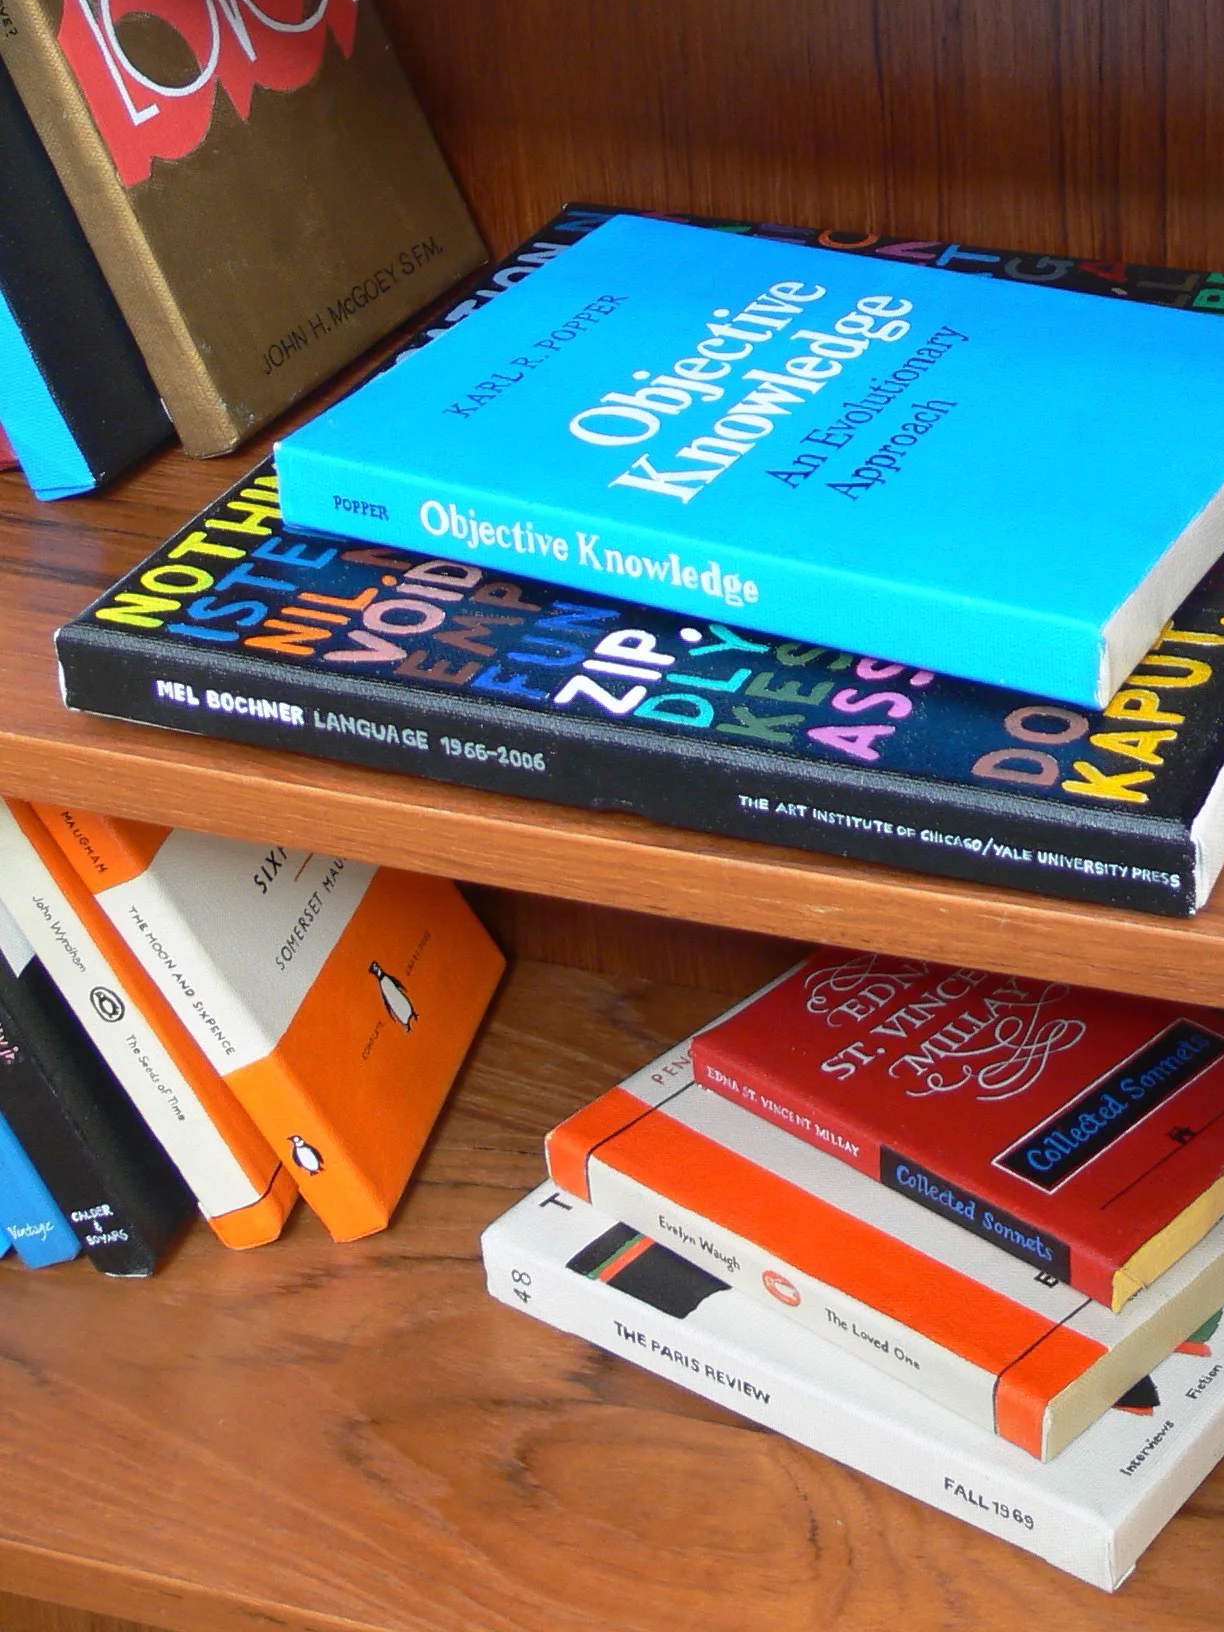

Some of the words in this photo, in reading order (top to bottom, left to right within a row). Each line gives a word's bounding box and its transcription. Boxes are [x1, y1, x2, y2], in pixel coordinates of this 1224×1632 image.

[263, 325, 308, 375] JOHN
[308, 312, 332, 340] H.
[328, 264, 399, 327] McGOEY
[442, 371, 524, 419] KARL
[533, 294, 629, 352] POPPER
[569, 280, 827, 446] Objective
[608, 294, 914, 505] Knowledge
[765, 453, 828, 489] An
[801, 325, 970, 450] Evolutionary
[826, 398, 958, 501] Approach
[333, 494, 390, 522] POPPER
[419, 499, 569, 561] Objective
[577, 531, 759, 608] Knowledge
[245, 575, 397, 656] NIL.
[324, 559, 483, 663] VOID
[553, 626, 702, 716] ZIP.
[156, 678, 200, 708] MEL
[206, 688, 305, 728] BOCHNER
[313, 709, 429, 751] LANGUAGE
[440, 735, 546, 772] 1966-2006
[61, 810, 107, 874] MAUGHAM
[737, 794, 769, 813] THE
[775, 800, 808, 820] ART
[812, 808, 896, 838] INSTITUTE
[897, 824, 917, 841] OF
[1037, 851, 1129, 880] UNIVERSITY
[1131, 866, 1181, 890] PRESS
[32, 894, 53, 922] John
[50, 921, 86, 973] Wyndham
[275, 891, 324, 971] SOMERSET
[322, 856, 348, 894] MAU
[128, 905, 147, 932] THE
[146, 931, 177, 970] MOON
[172, 973, 194, 997] AND
[193, 1000, 236, 1057] SIXPENCE
[888, 976, 1030, 1079] MILLAY
[126, 1034, 140, 1055] The
[157, 1081, 172, 1099] of
[167, 1095, 186, 1122] Time
[821, 1040, 886, 1081] ST.
[1026, 1092, 1129, 1171] Collected
[1120, 1033, 1210, 1100] Sonnets
[706, 1065, 740, 1093] EDNA
[760, 1095, 811, 1130] VINCENT
[814, 1123, 860, 1157] MILLAY
[658, 1214, 697, 1246] Evelyn
[699, 1238, 741, 1273] Waugh
[895, 1164, 976, 1221] Collected
[983, 1211, 1053, 1262] Sonnets
[613, 1320, 646, 1347] THE
[651, 1339, 700, 1373] PARIS
[705, 1366, 771, 1405] REVIEW
[824, 1307, 849, 1332] The
[851, 1323, 890, 1355] Loved
[893, 1347, 921, 1371] One
[1119, 1418, 1175, 1478] Interviews
[1185, 1362, 1223, 1401] Fiction
[944, 1476, 989, 1511] FALL
[991, 1500, 1035, 1531] 1969
